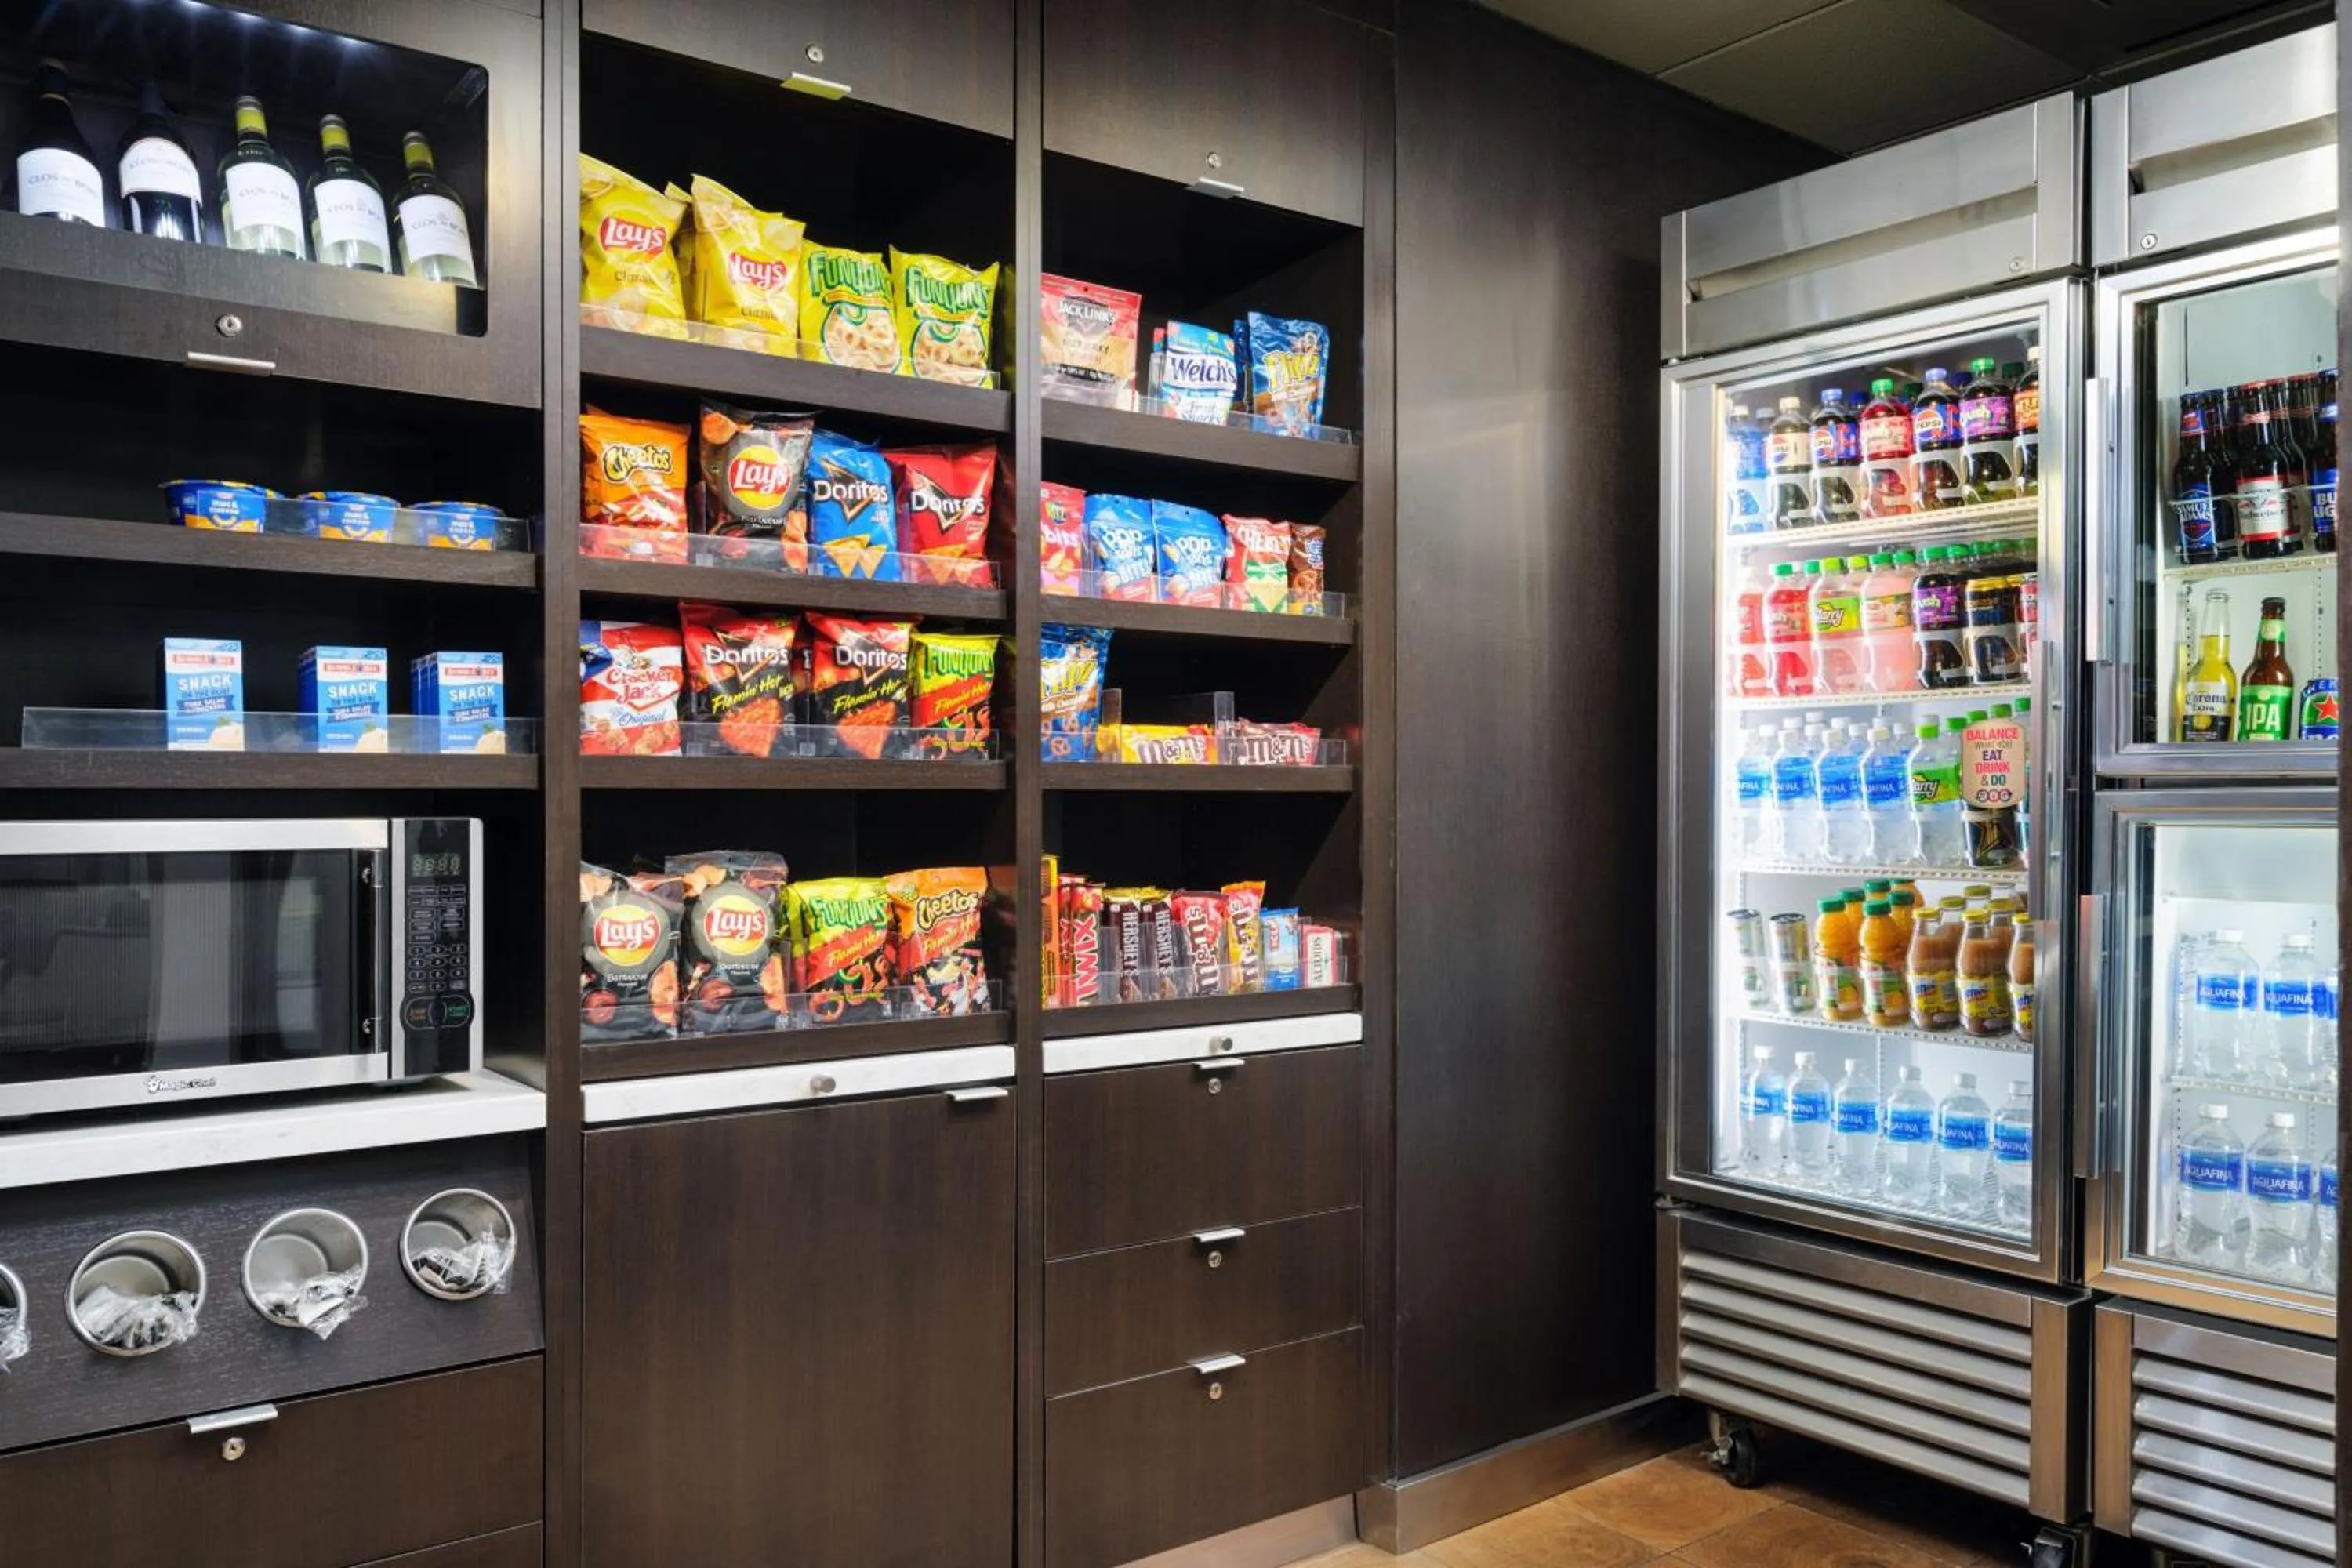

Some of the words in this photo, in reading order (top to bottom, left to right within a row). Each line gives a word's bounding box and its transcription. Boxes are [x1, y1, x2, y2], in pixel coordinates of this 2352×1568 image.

[604, 217, 666, 252] Lay's
[731, 252, 788, 289] Lay's
[1171, 356, 1237, 383] Welch's
[603, 445, 672, 482] Cheetos
[735, 459, 790, 495] Lay's
[813, 480, 888, 503] Doritos
[2314, 493, 2336, 506] BU
[910, 491, 985, 514] Doritos
[2314, 505, 2335, 518] LIG
[706, 644, 789, 666] Doritos
[835, 644, 907, 670] Doritos
[177, 674, 233, 691] SNACK
[606, 667, 673, 684] Cracker
[758, 674, 784, 694] Hot
[326, 681, 377, 699] SNACK
[448, 684, 495, 702] SNACK
[2185, 692, 2227, 706] Corona
[2245, 703, 2281, 731] IPA
[1966, 728, 2020, 742] BALANCE
[1982, 750, 2004, 761] EAT
[1975, 762, 2011, 775] DRINK
[1980, 775, 1989, 785] &
[1991, 775, 2007, 786] DO
[916, 889, 980, 931] Cheetos
[601, 913, 658, 951] Lay's
[710, 904, 764, 941] Lay's
[1073, 913, 1102, 1007] TWIX
[1312, 936, 1324, 982] ALTOIDS
[1944, 1127, 1976, 1142] UAFINA
[2183, 1165, 2234, 1181] AQUAFINA
[2252, 1177, 2305, 1193] AQUAFINA
